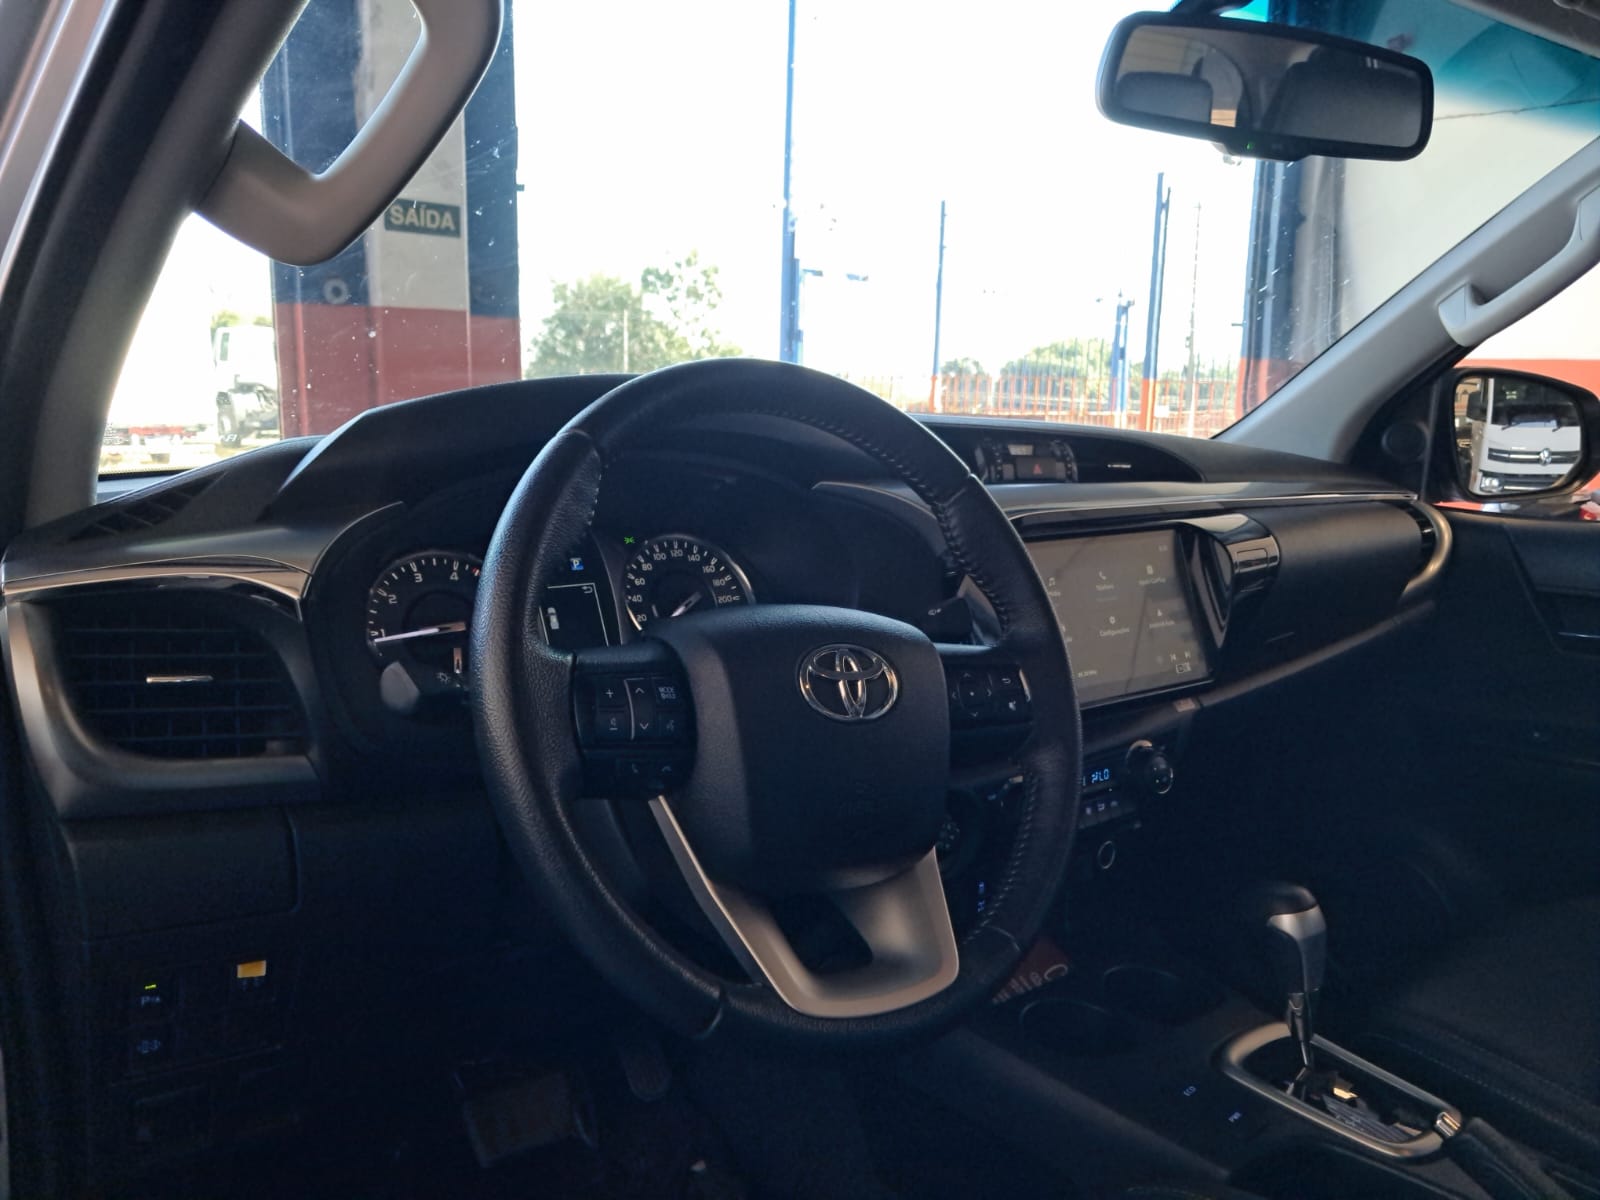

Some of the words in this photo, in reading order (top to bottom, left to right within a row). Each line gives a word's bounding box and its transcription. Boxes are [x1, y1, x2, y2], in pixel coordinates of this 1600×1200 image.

[389, 204, 456, 231] SAÍDA
[653, 553, 667, 561] 100
[670, 549, 684, 557] 120
[687, 554, 701, 562] 140
[641, 562, 653, 571] 80
[702, 565, 716, 573] 160
[415, 574, 423, 583] 3
[449, 571, 459, 581] 4
[634, 578, 646, 586] 60
[388, 594, 398, 604] 2
[632, 594, 643, 603] 40
[718, 595, 732, 603] 200
[636, 614, 648, 622] 20
